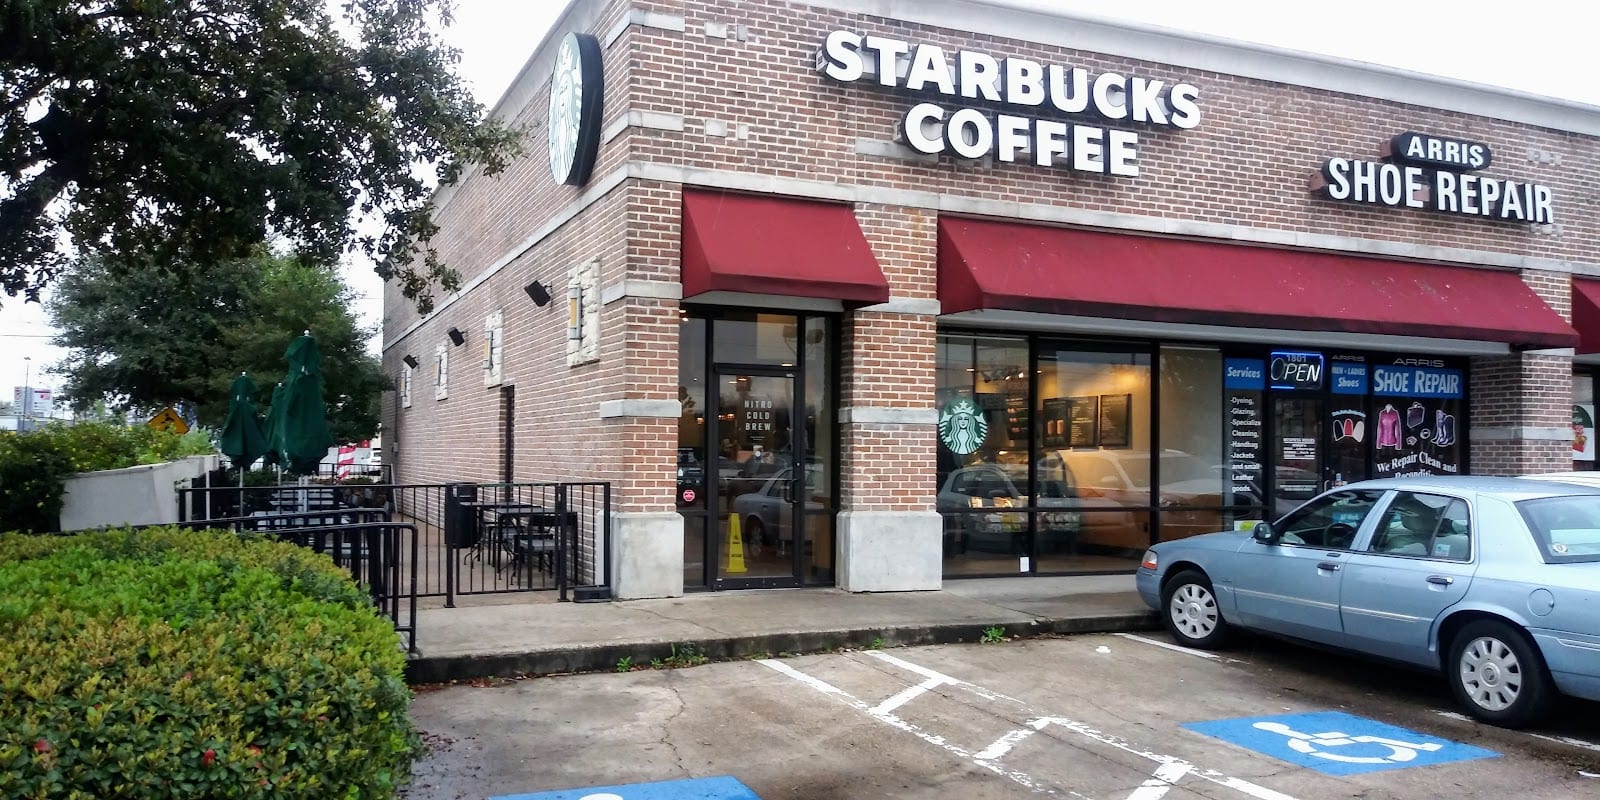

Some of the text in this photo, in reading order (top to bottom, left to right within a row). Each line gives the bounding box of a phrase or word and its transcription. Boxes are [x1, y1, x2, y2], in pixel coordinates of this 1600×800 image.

[824, 30, 1201, 129] STARBUCKS
[904, 102, 1140, 177] COFFEE
[1407, 136, 1484, 167] ARRIS
[1328, 157, 1554, 223] SHOE REPAIR
[1227, 366, 1261, 379] Services
[1270, 357, 1321, 382] OPEN
[1393, 358, 1445, 368] ARRIS
[1338, 377, 1360, 388] Shoes
[1374, 369, 1459, 394] SHOE REPAIR
[744, 400, 772, 409] NITRO
[746, 411, 770, 419] COLD
[745, 422, 771, 431] BREW
[1377, 451, 1457, 472] We Repair Clean and
